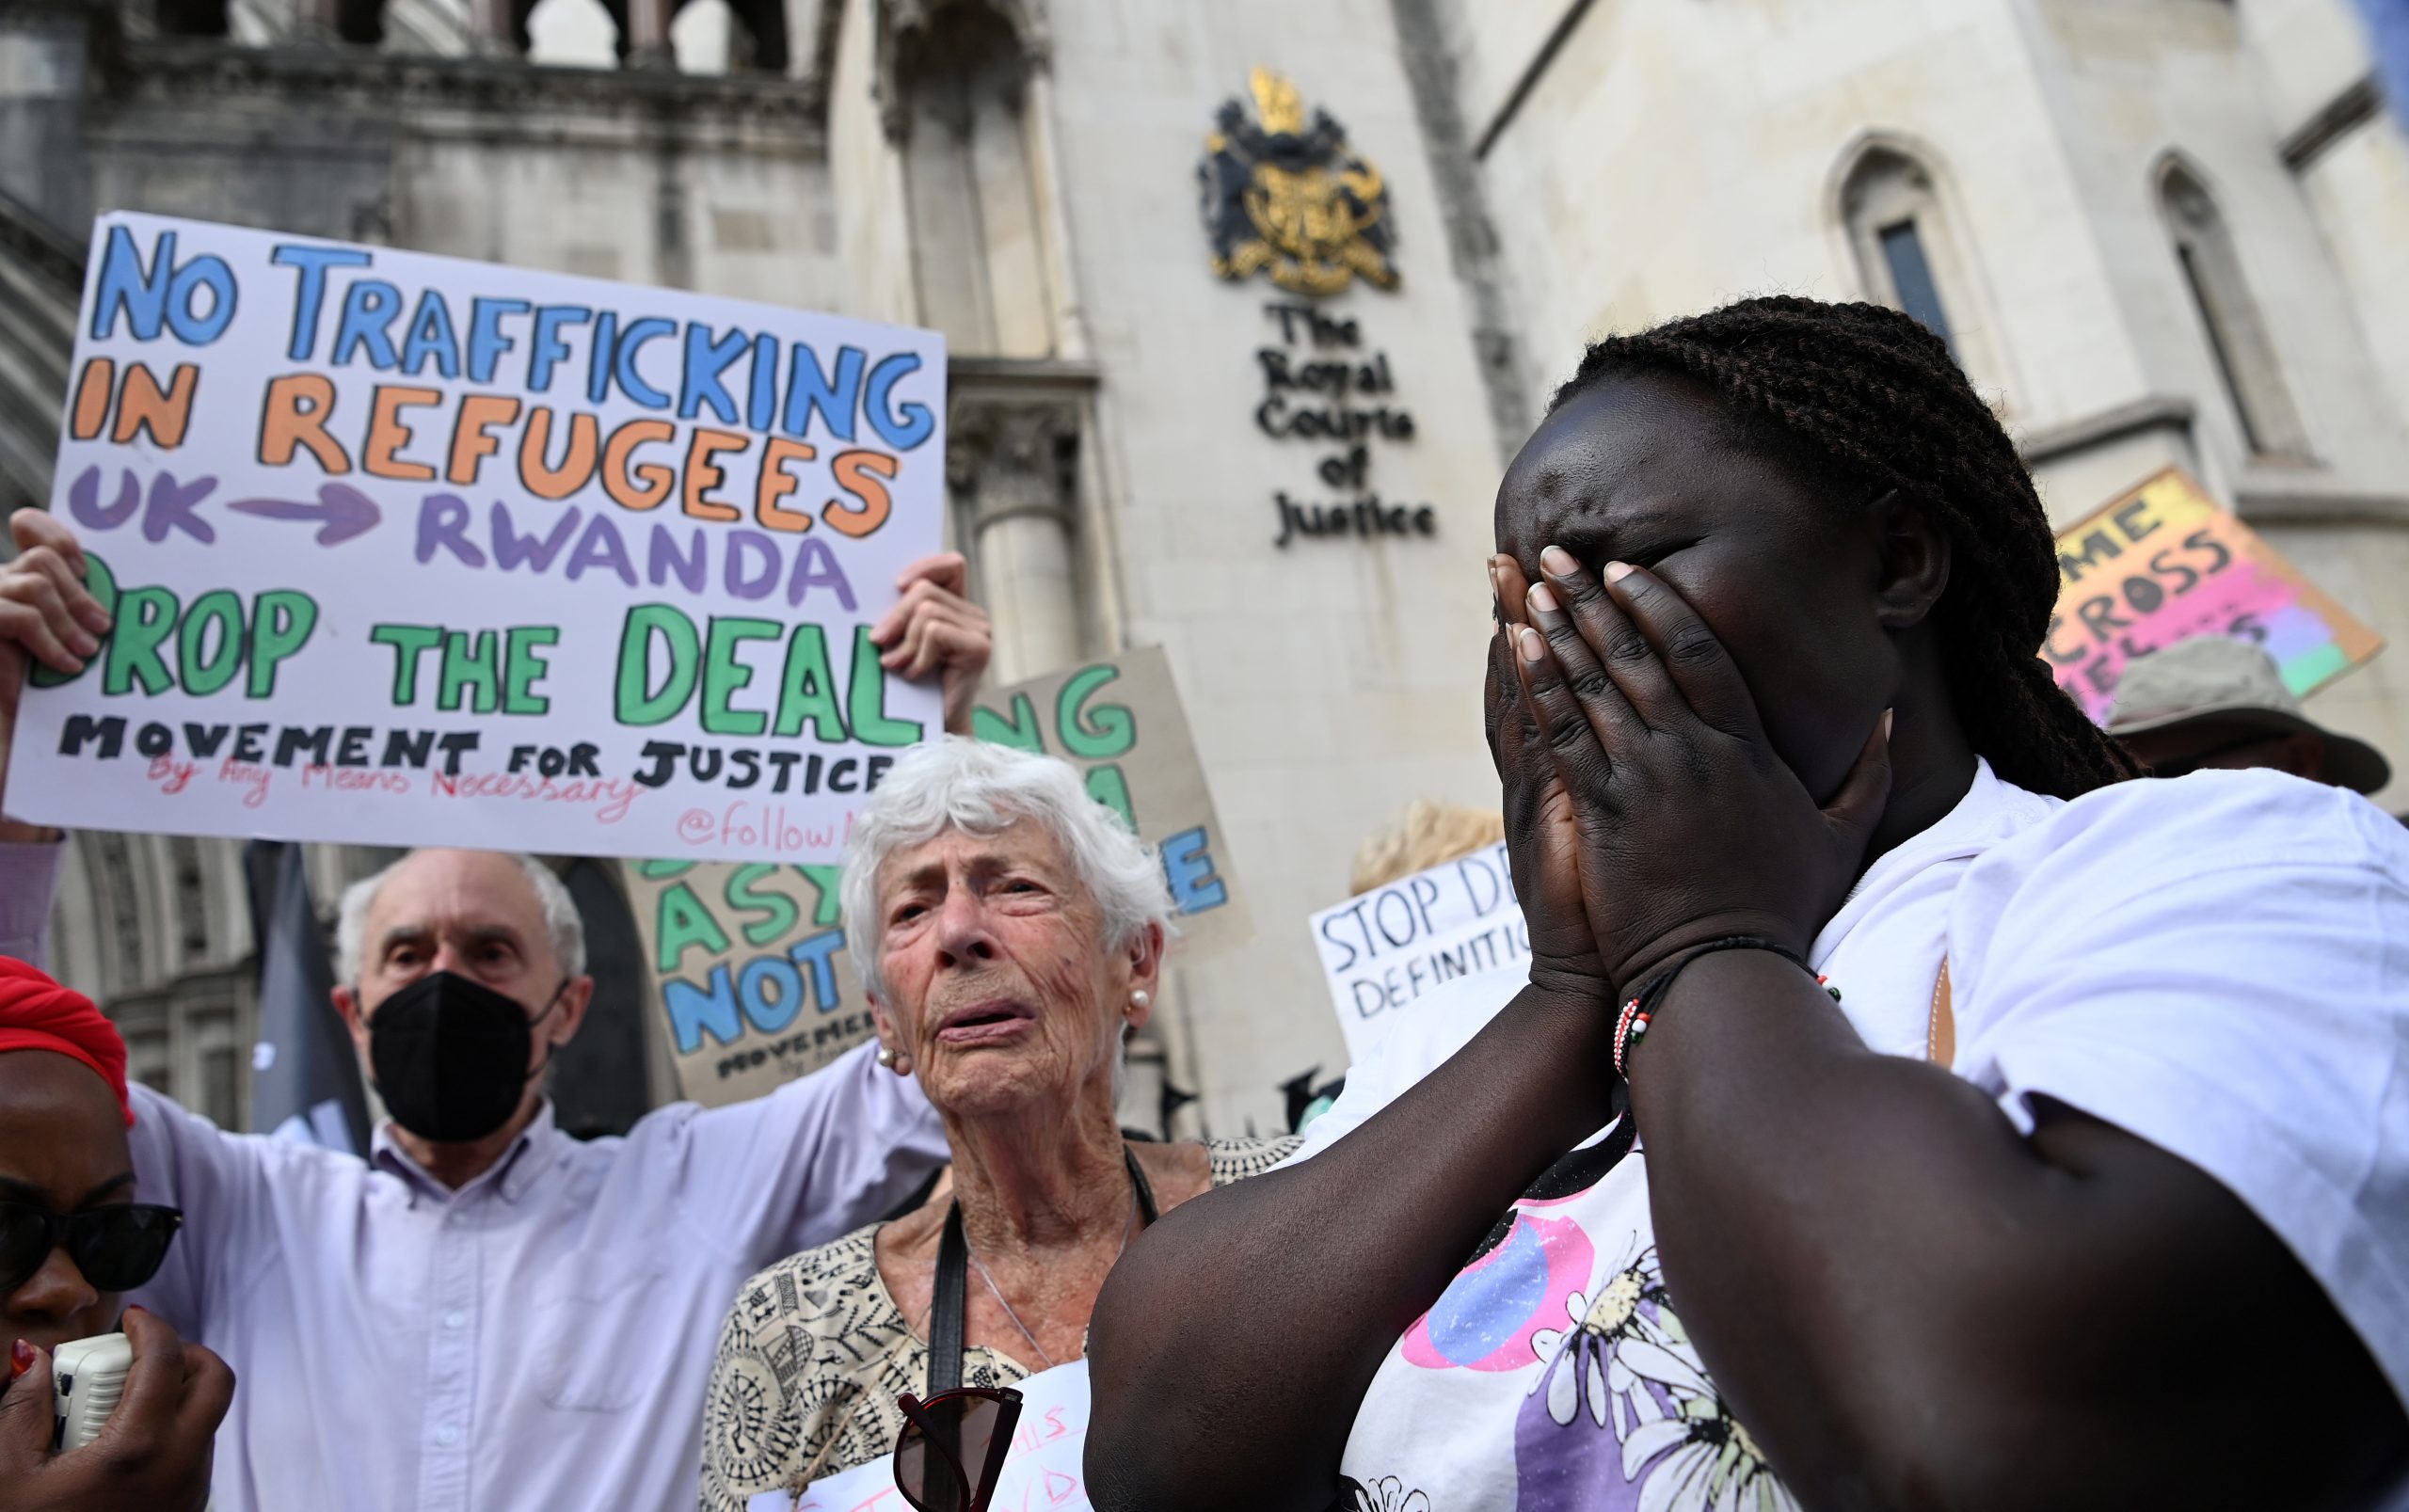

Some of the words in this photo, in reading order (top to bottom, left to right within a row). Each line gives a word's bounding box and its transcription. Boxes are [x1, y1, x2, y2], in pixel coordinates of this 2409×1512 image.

[90, 225, 238, 346] NO
[270, 245, 935, 452] TRAFFICKING
[1262, 303, 1361, 347] The
[1255, 347, 1395, 396] Royal
[70, 357, 200, 450] IN
[257, 373, 901, 539] REFUGEES
[1253, 392, 1416, 441] Courts
[1316, 444, 1370, 490] of
[69, 465, 218, 545] UK
[415, 493, 858, 613] RWANDA
[1271, 491, 1437, 550] Justice
[368, 623, 560, 717] THE
[614, 602, 925, 747] DEAL
[57, 713, 481, 777] MOVEMENT
[506, 741, 602, 779] FOR
[632, 740, 895, 796] JUSTICE
[147, 751, 200, 796] By
[218, 756, 272, 809] Any
[302, 760, 410, 794] Means
[430, 769, 647, 825] Necessary
[1322, 874, 1439, 973] STOP
[662, 926, 846, 1056] NOT
